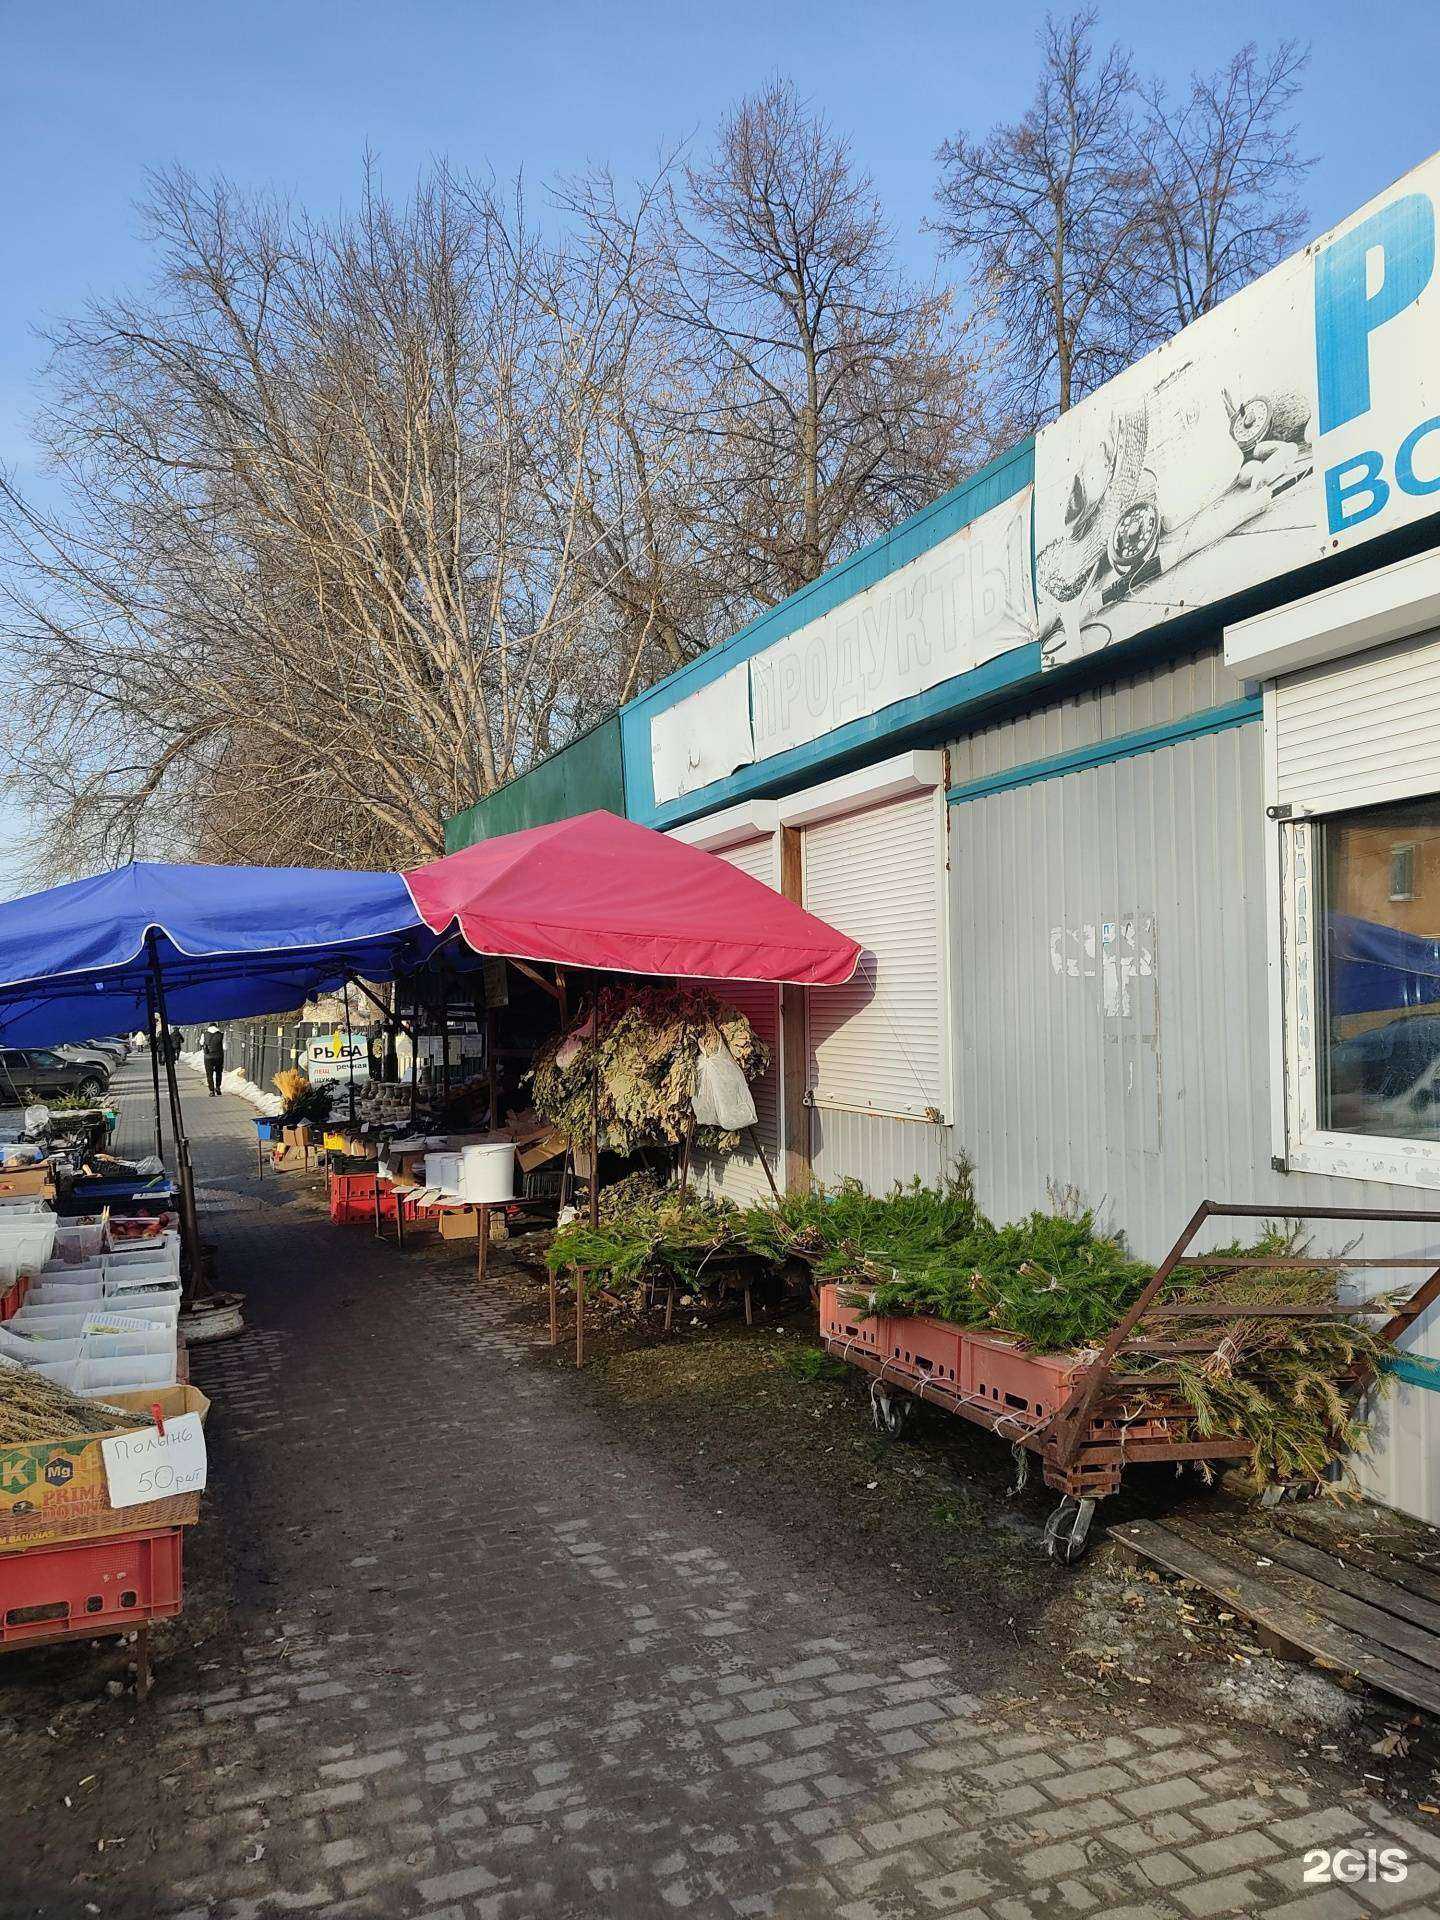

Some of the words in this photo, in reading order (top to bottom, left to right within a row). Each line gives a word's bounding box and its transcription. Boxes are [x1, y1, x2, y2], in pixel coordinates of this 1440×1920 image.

[752, 513, 1031, 742] ПРОДУКТЫ
[313, 1045, 362, 1059] РЫБА
[47, 1466, 71, 1479] Mg
